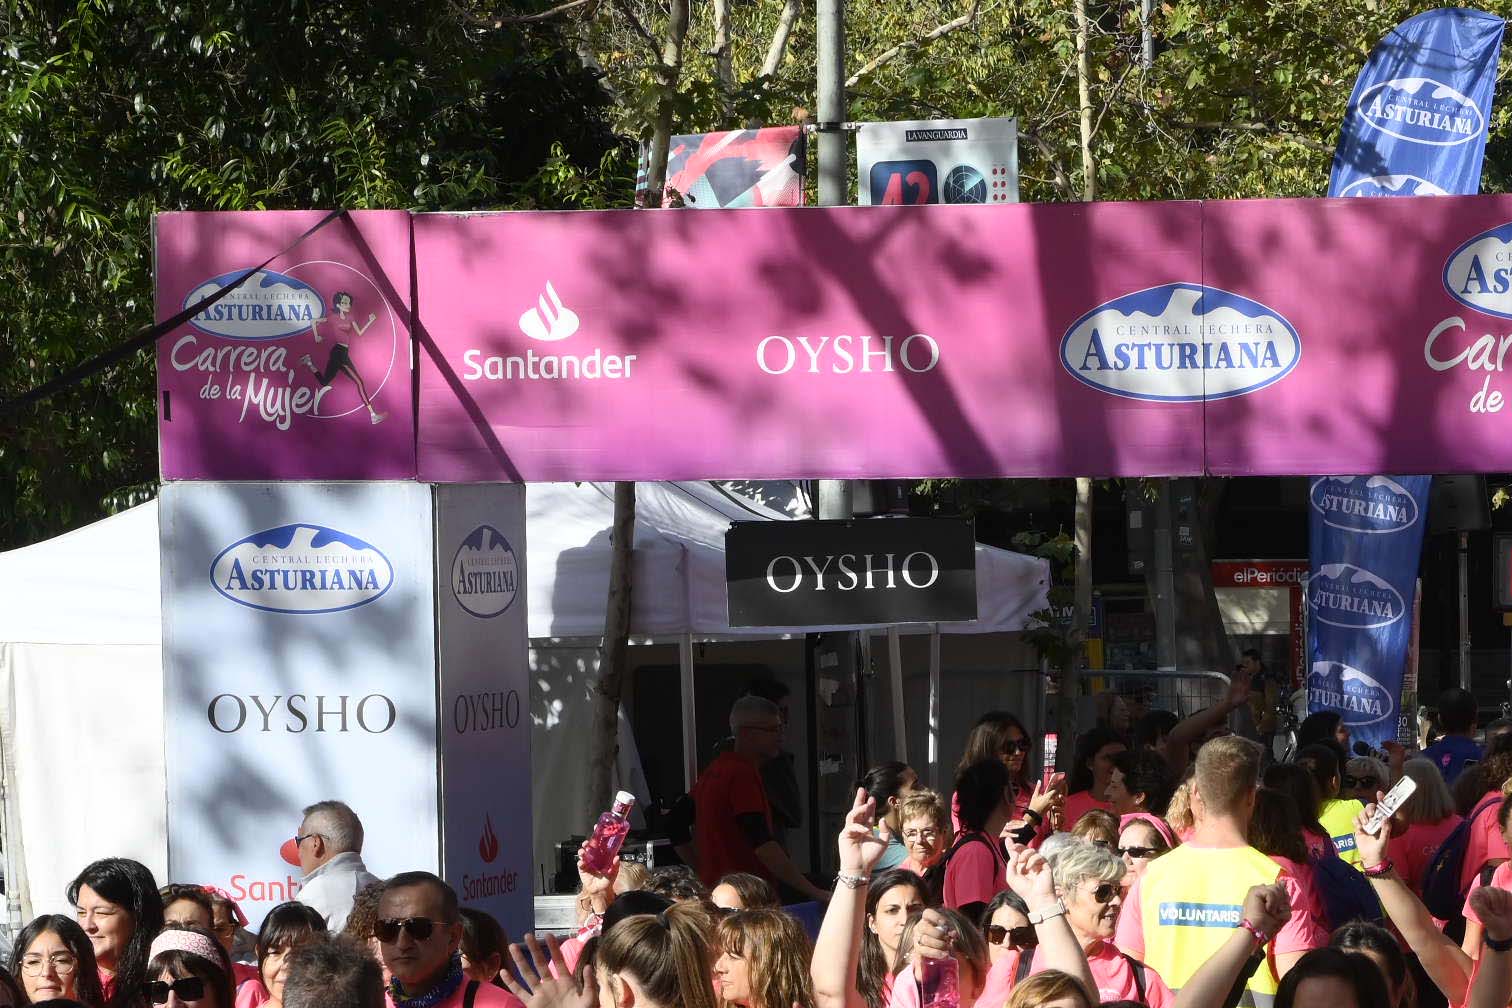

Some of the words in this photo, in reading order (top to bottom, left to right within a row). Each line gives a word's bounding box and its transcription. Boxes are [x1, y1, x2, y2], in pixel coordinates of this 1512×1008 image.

[1365, 93, 1473, 135] ASTURIANA
[192, 295, 313, 322] ASTURIANA
[224, 293, 260, 301] ENTRAL
[1116, 324, 1192, 336] CENTRAL
[1198, 323, 1274, 335] LECHERA
[170, 334, 288, 373] Carrera
[463, 348, 637, 381] Santander
[755, 333, 940, 374] OYSHO
[1079, 327, 1282, 371] ASTURIANA
[199, 375, 222, 400] de
[226, 374, 242, 400] la
[239, 369, 333, 430] Mujer
[1470, 374, 1505, 414] de
[225, 557, 381, 591] ASTURIANA
[252, 554, 310, 564] CENTRAL
[316, 554, 374, 564] LECHERA
[766, 551, 939, 593] OYSHO
[456, 560, 516, 595] ASTURIANA
[207, 693, 397, 734] OYSHO
[454, 689, 520, 735] OYSHO
[230, 874, 297, 901] Sant
[462, 871, 519, 901] Santander
[1159, 908, 1240, 923] VOLUNTARIS
